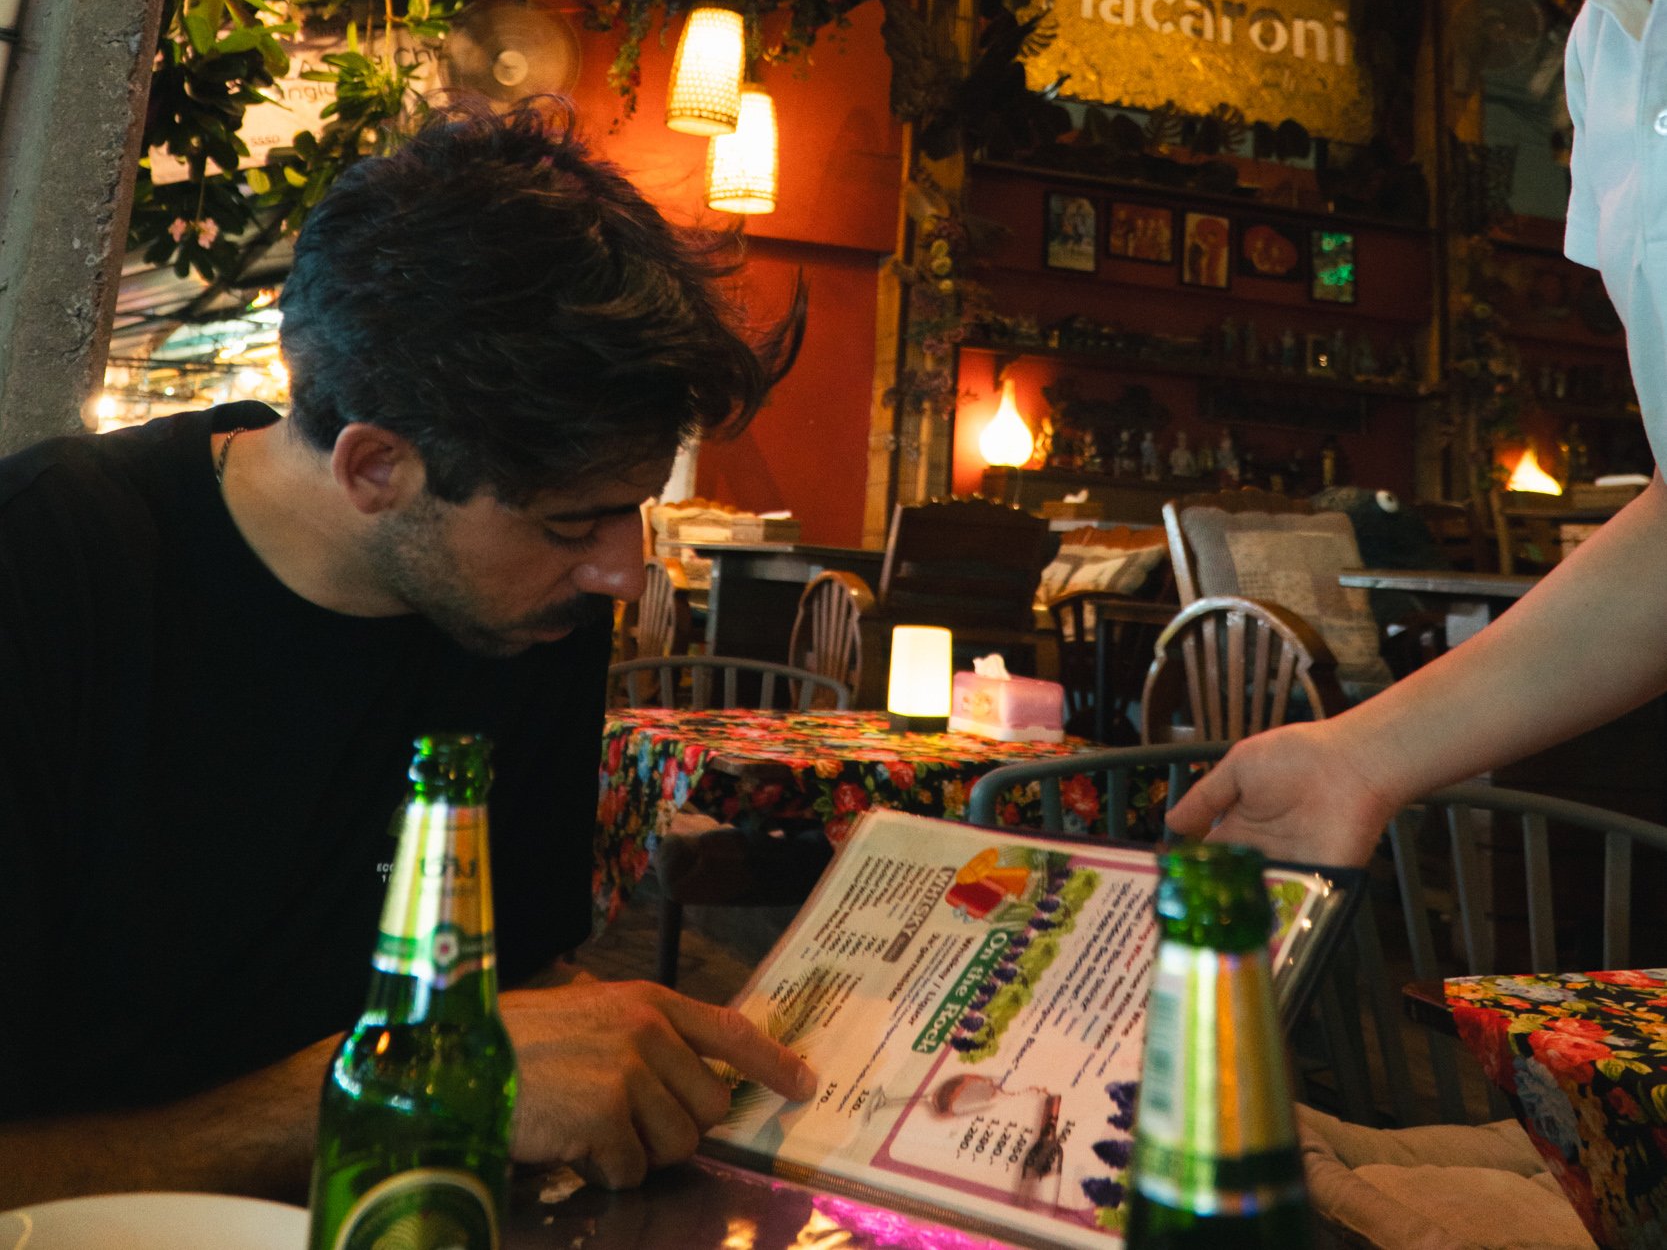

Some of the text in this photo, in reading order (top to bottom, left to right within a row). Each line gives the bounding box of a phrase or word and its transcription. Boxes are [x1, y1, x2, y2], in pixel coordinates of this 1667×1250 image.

[902, 866, 952, 936] WHISKY
[979, 927, 1009, 962] On
[954, 965, 983, 998] the
[916, 1002, 959, 1057] Rock
